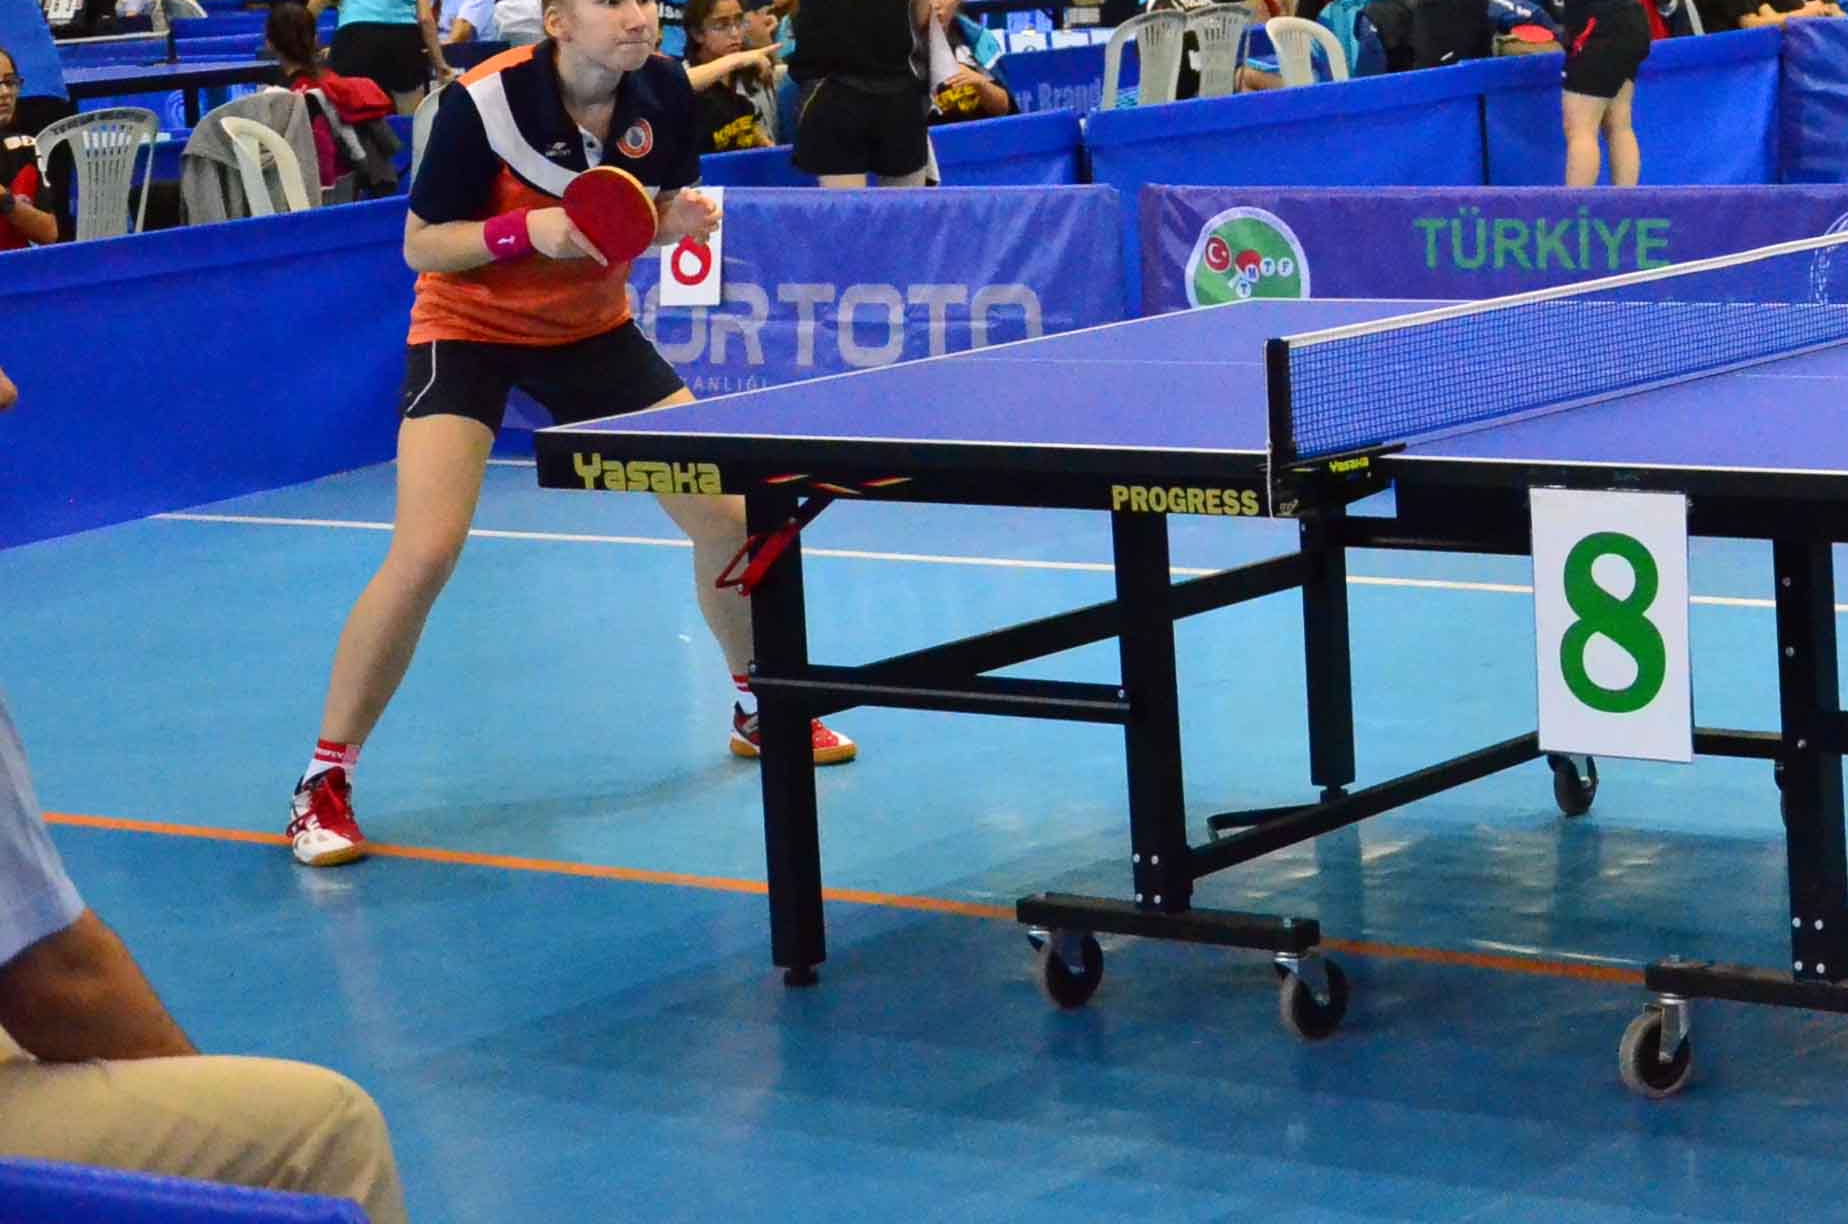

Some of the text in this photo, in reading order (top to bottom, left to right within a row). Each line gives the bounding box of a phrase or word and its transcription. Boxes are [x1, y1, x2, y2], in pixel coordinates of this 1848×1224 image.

[1413, 205, 1672, 270] TÜRKİYE
[622, 282, 1043, 367] ORTOTO
[574, 452, 722, 494] Yasaka
[1113, 483, 1260, 517] PROGRESS
[1561, 531, 1666, 714] 8
